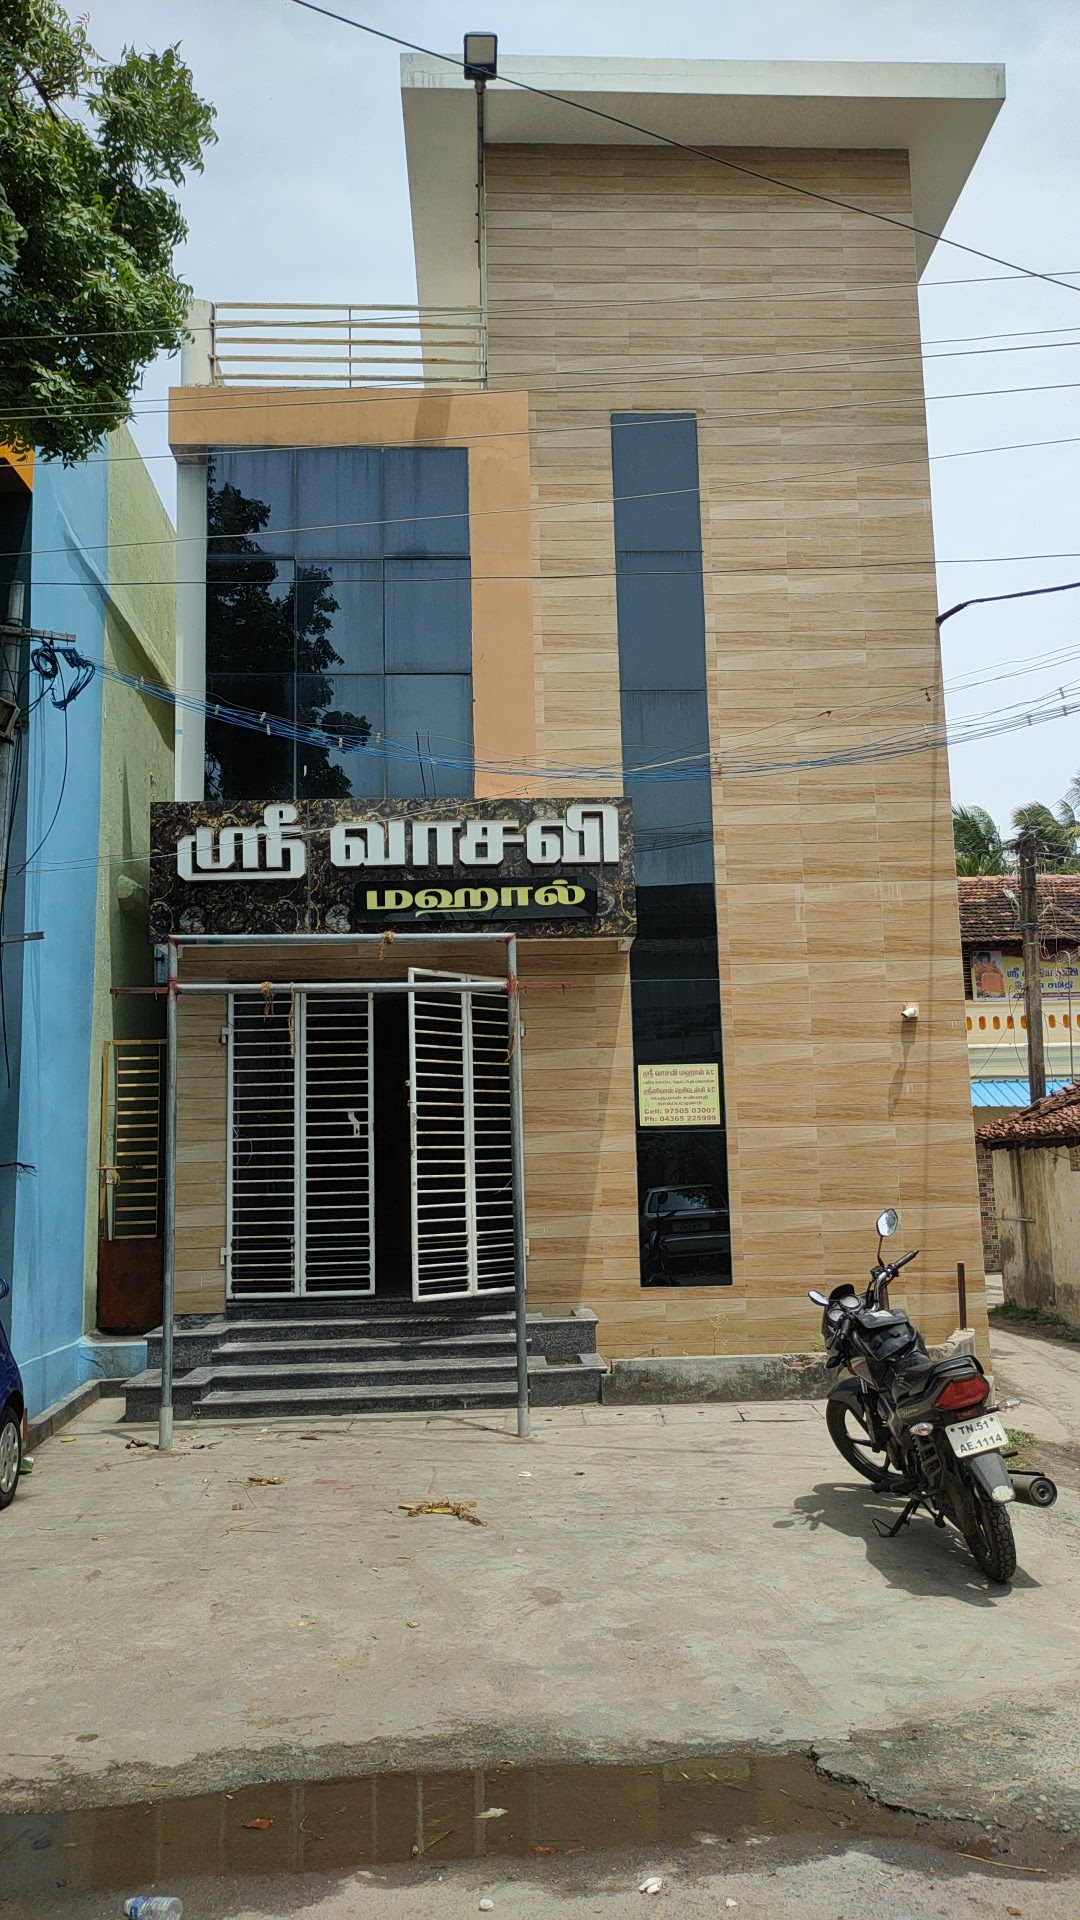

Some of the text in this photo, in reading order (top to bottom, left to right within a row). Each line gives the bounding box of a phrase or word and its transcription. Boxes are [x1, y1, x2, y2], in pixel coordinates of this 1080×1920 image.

[177, 804, 620, 881] ஸ்ரீ வாசவி
[366, 879, 586, 918] மஹால்
[958, 1420, 990, 1435] TN.51
[960, 1433, 1003, 1453] AE.1114
